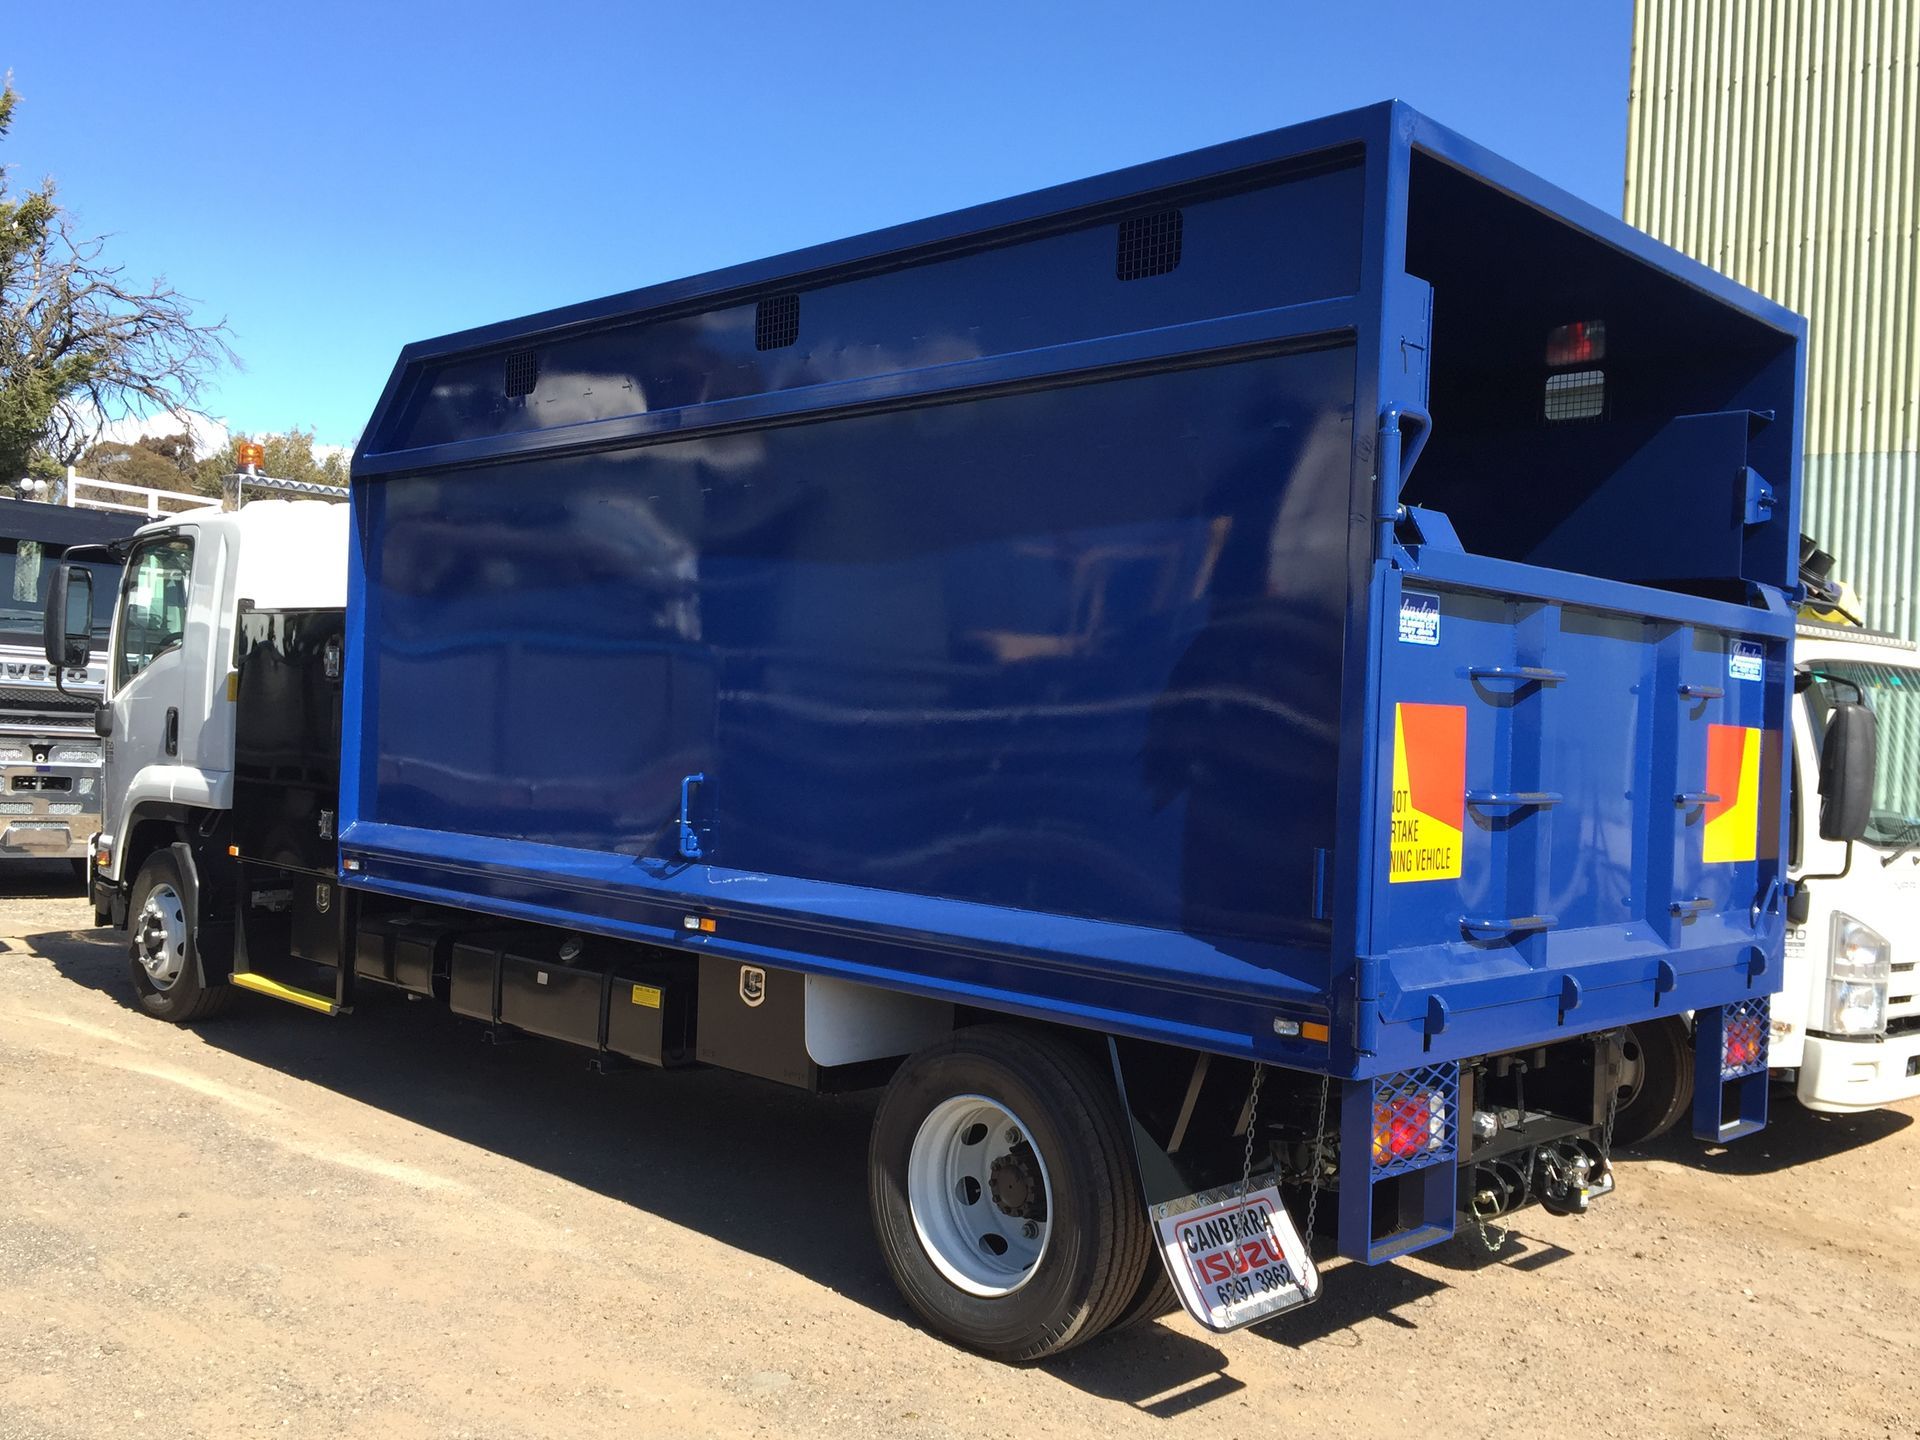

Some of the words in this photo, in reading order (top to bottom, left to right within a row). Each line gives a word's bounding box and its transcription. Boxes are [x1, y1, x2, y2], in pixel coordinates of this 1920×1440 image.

[1415, 847, 1451, 871] VEHICLE
[1183, 1205, 1274, 1254] CANBERRA
[1195, 1234, 1285, 1286] ISUZU
[1255, 1263, 1296, 1293] 3862
